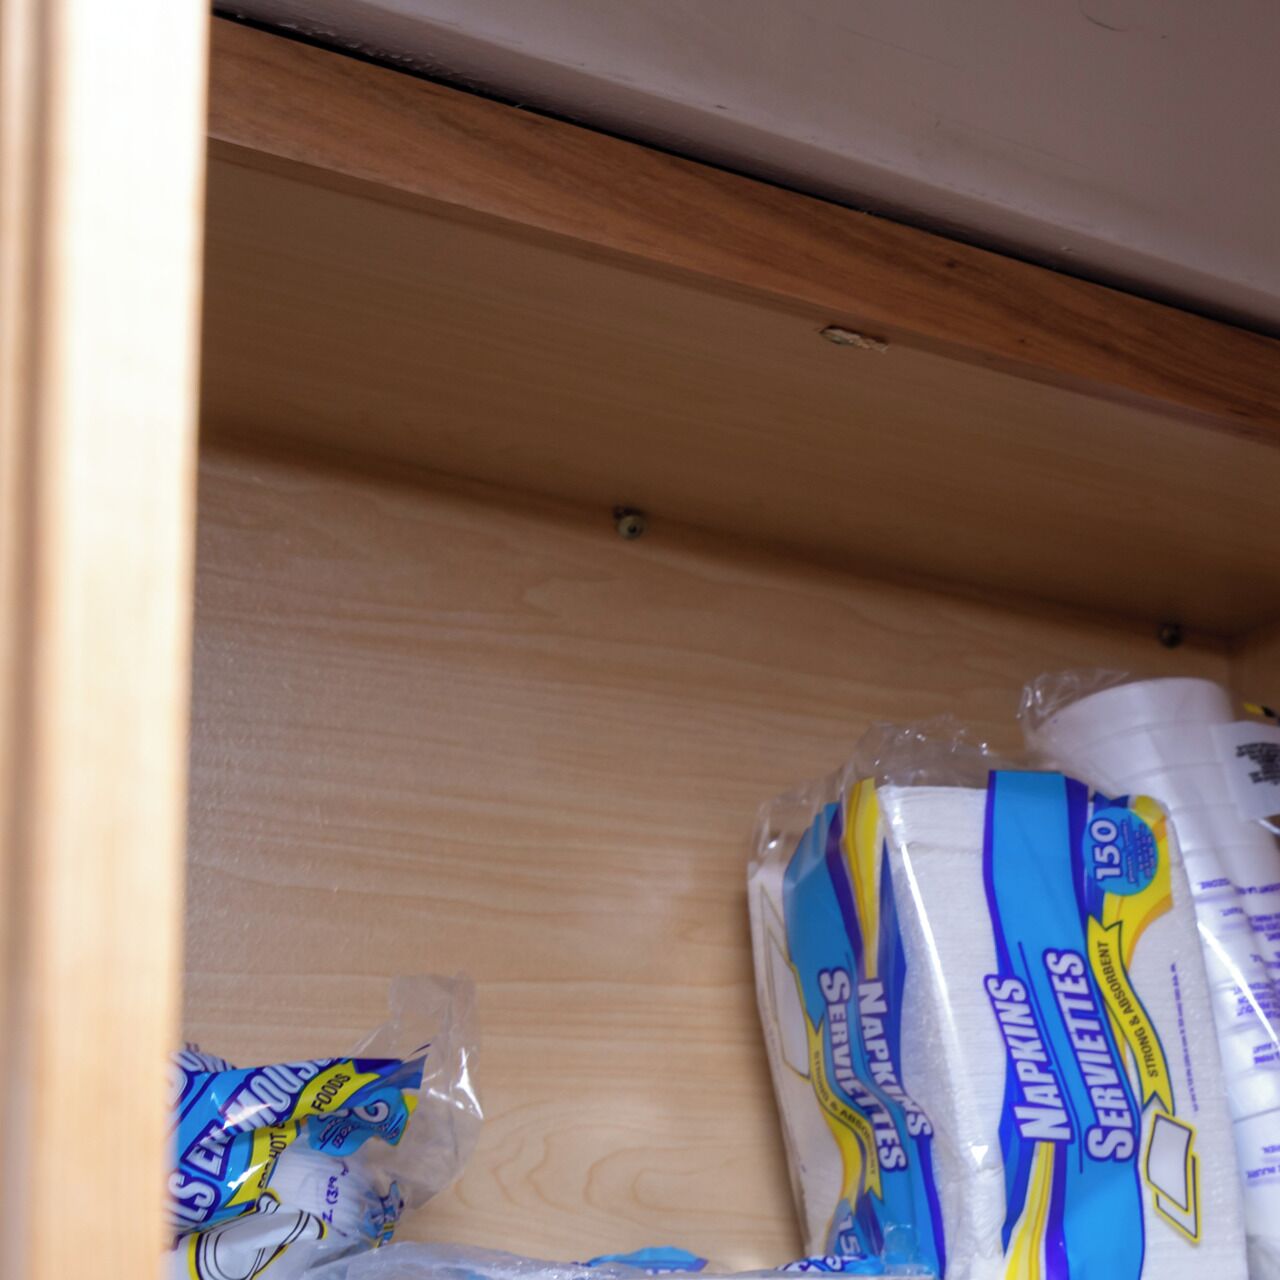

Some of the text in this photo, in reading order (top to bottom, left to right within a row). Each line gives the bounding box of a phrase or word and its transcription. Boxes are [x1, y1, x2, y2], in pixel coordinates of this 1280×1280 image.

[1092, 821, 1120, 881] 150
[985, 976, 1073, 1141] NAPKINS
[1046, 951, 1135, 1161] SERVIETTES
[1096, 940, 1158, 1078] STRONG & ABSORBENT
[312, 1072, 351, 1111] FOODS
[269, 1131, 287, 1160] HOT
